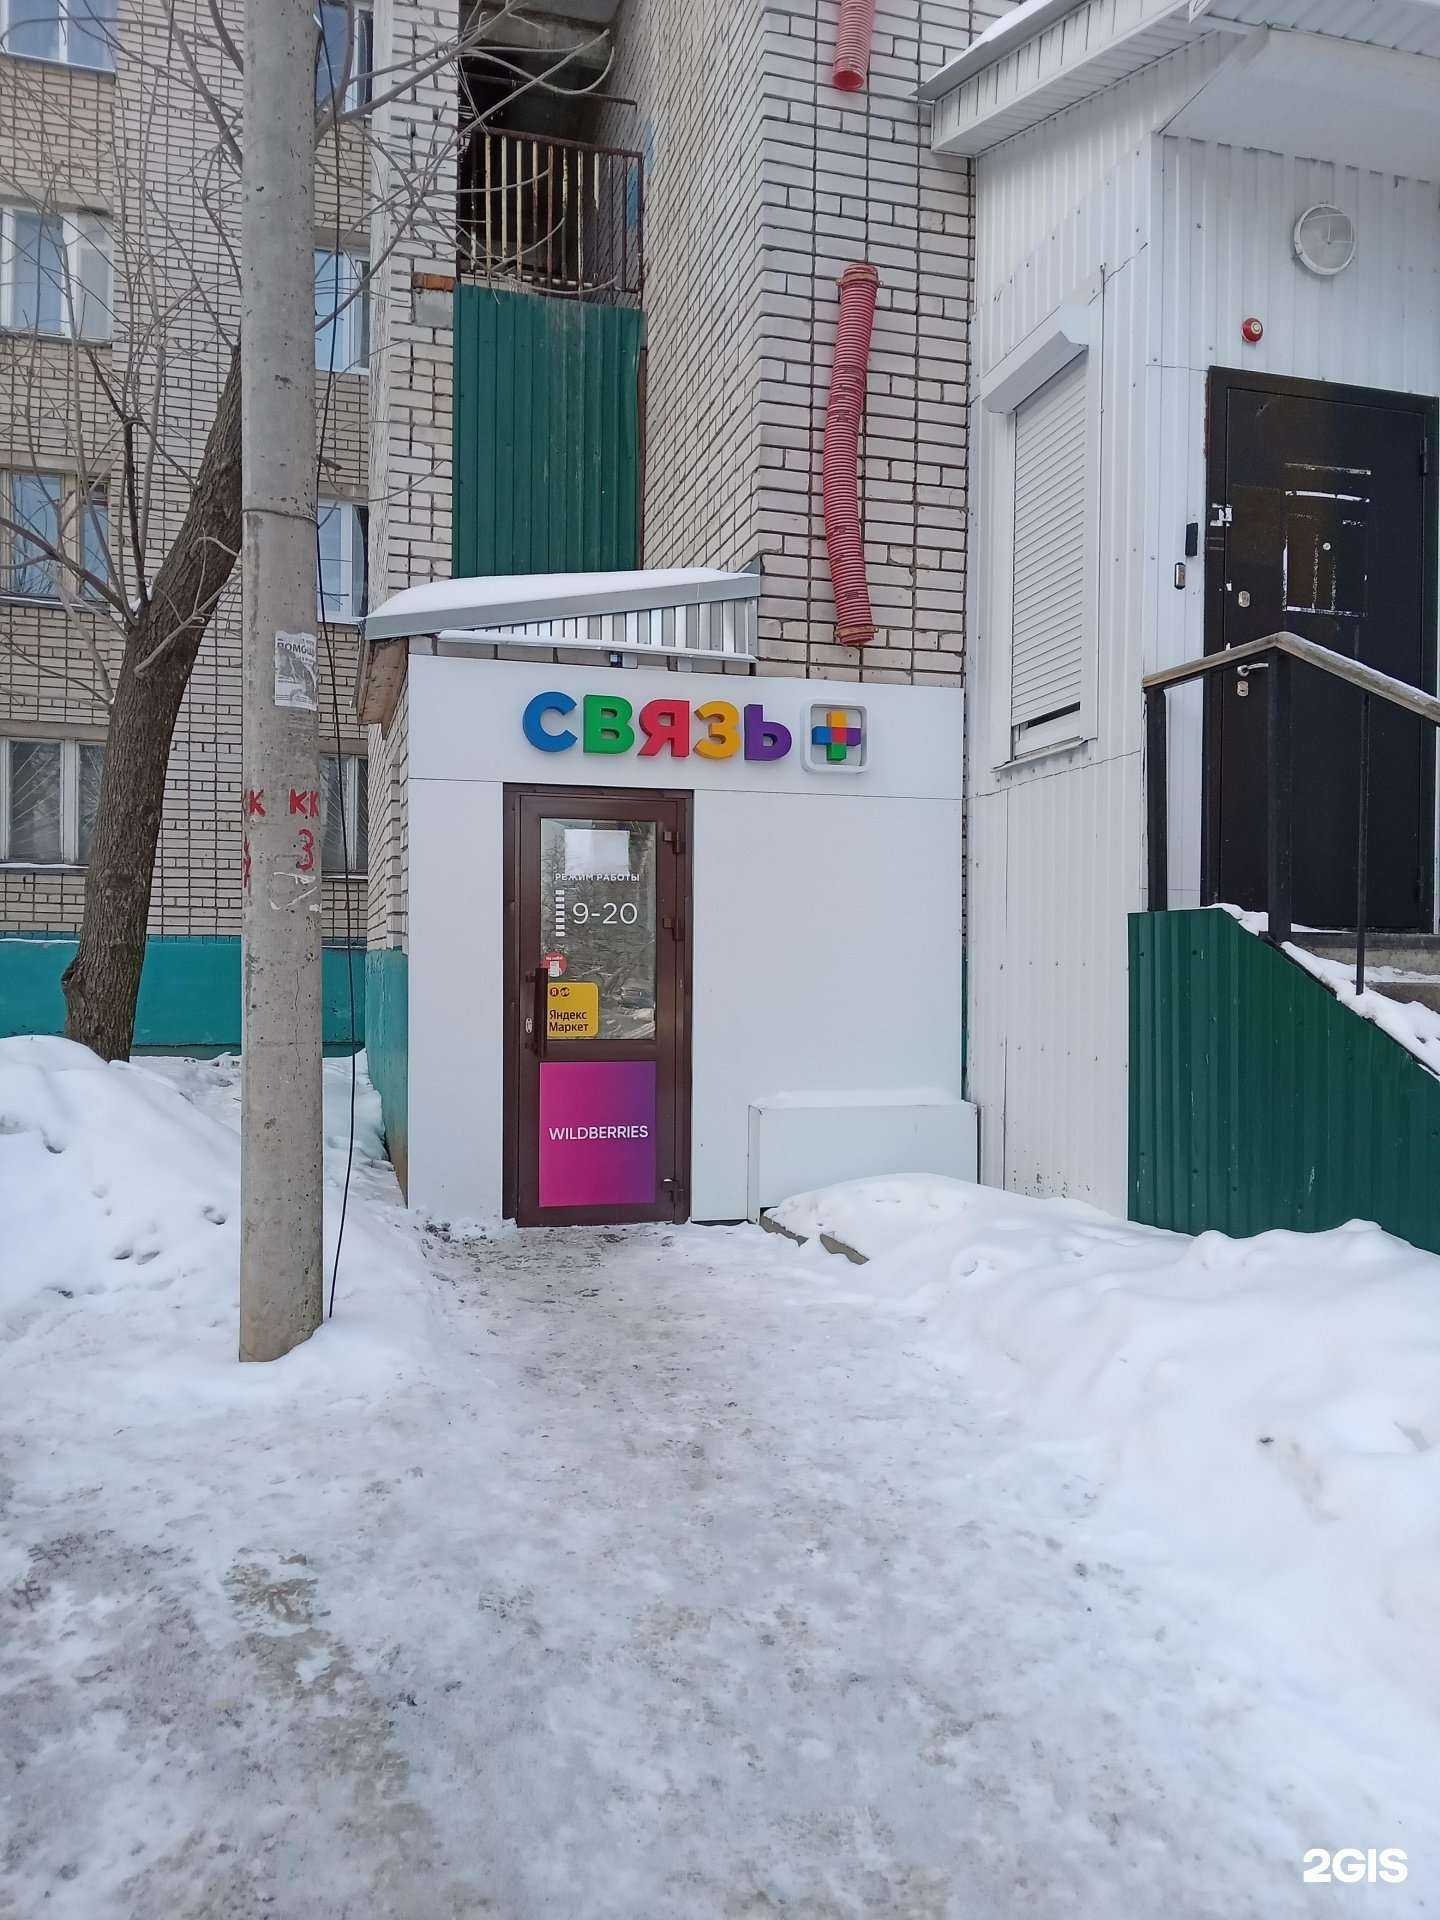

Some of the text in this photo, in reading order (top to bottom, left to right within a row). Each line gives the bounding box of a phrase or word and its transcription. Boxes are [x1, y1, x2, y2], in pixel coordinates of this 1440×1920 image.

[522, 691, 793, 761] СВЯЗЬ
[555, 873, 640, 882] РЕЖИМ РАБОТЫ
[572, 902, 638, 924] 9-20
[549, 1009, 587, 1021] Яндекс
[549, 1022, 588, 1033] Маркет
[549, 1125, 649, 1140] WILDBERRIES
